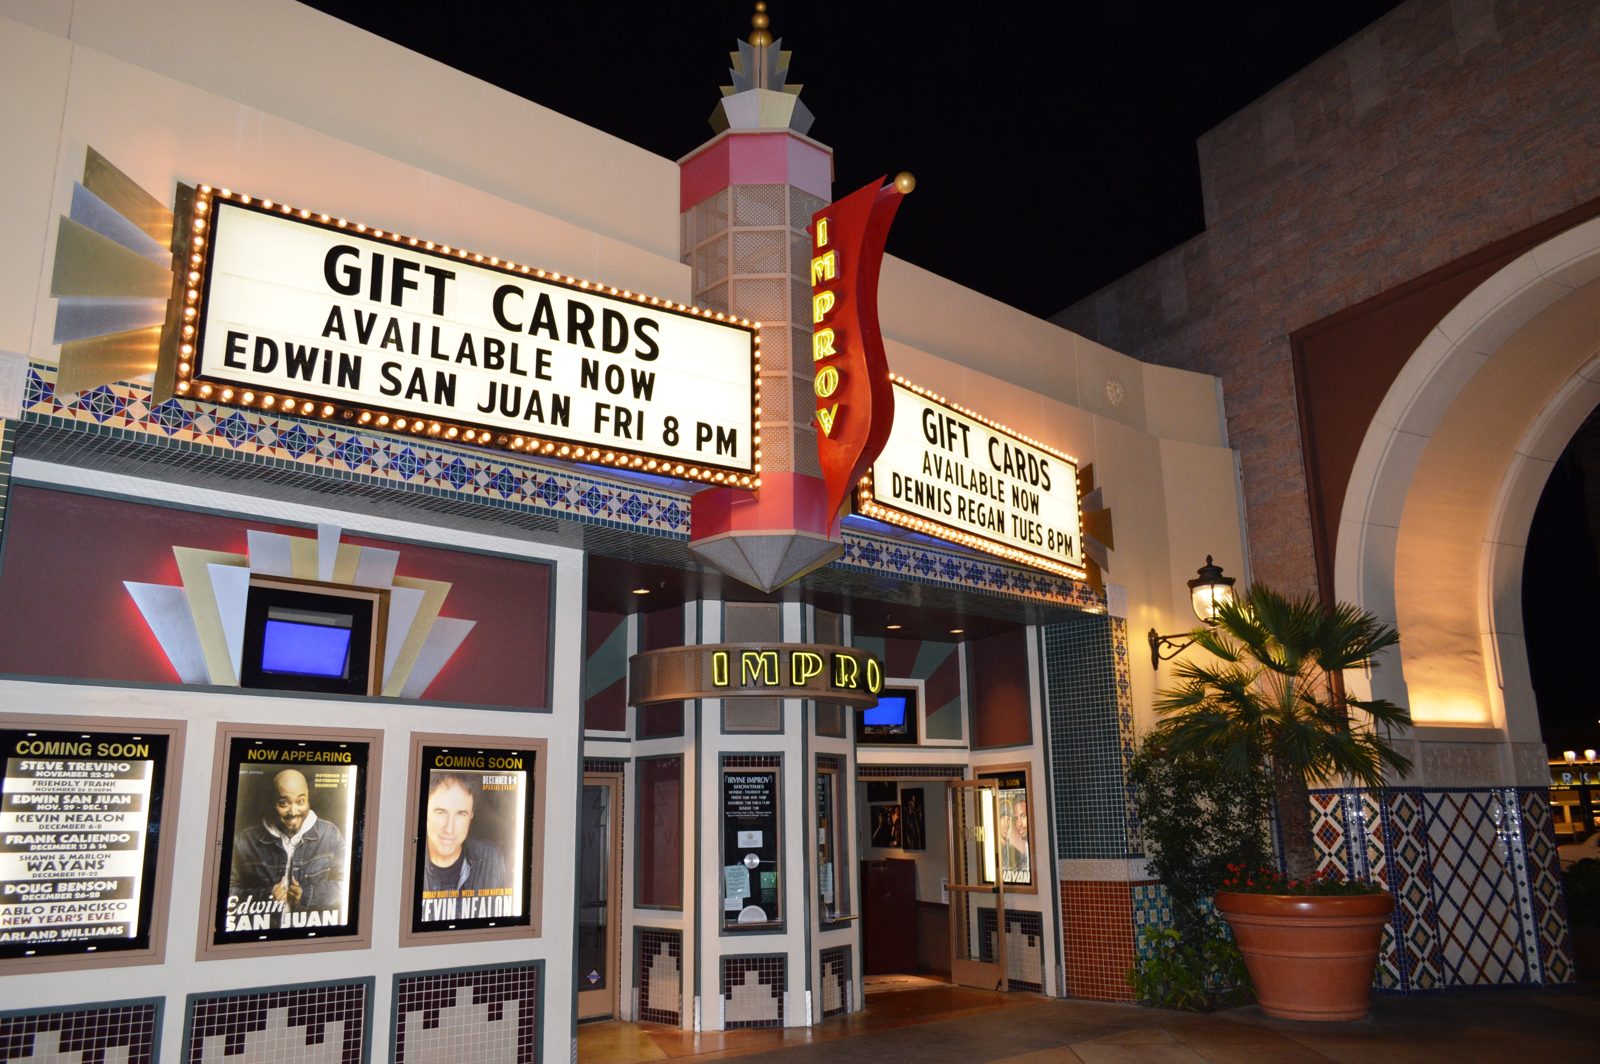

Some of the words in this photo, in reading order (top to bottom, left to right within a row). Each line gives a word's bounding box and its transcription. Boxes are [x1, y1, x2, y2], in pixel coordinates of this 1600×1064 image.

[323, 245, 456, 317] GIFT
[492, 284, 660, 361] CARDS
[811, 216, 840, 438] IMPROV
[322, 305, 553, 382] AVAILABLE
[581, 359, 656, 402] NOW
[223, 331, 362, 390] EDWIN
[380, 362, 457, 407] SAN
[477, 382, 571, 428] JUAN
[594, 403, 645, 441] FRI
[663, 416, 680, 447] 8
[696, 423, 738, 458] PM
[922, 407, 970, 458] GIFT
[988, 436, 1051, 492] CARDS
[922, 450, 1005, 503] AVAILABLE
[1012, 484, 1040, 517] NOW
[892, 471, 952, 515] DENNIS
[958, 495, 1005, 534] REGAN
[1011, 514, 1043, 546] TUES
[1047, 528, 1055, 551] 8
[1057, 532, 1073, 558] PM
[712, 650, 885, 694] IMPRO
[16, 740, 92, 757] COMING
[97, 742, 150, 758] SOON
[248, 749, 279, 761] NOW
[281, 750, 352, 763] APPEARING
[20, 761, 63, 771] STEVE
[68, 762, 131, 772] TREVINO
[435, 755, 485, 768] COMING
[488, 757, 523, 769] SOON
[727, 776, 746, 784] IRVINE
[747, 776, 769, 784] IMPROV
[12, 795, 59, 804] EDWIN
[63, 795, 92, 804] SAN
[96, 795, 131, 804] JUAN
[16, 814, 60, 823] KEVIN
[65, 814, 125, 823] NEALON
[5, 834, 57, 844] FRANK
[60, 833, 130, 843] CALIENDO
[27, 860, 105, 872] WAYANS
[1002, 870, 1031, 884] AYAN
[4, 883, 52, 895] DOUG
[57, 881, 118, 892] BENSON
[22, 893, 72, 901] DECEMBER
[1, 905, 45, 916] ABLO
[50, 902, 127, 914] FRANCISCO
[227, 895, 285, 916] Edwin
[2, 916, 32, 926] NEW
[38, 913, 83, 924] YEAR'S
[87, 912, 115, 921] EVE!
[225, 913, 271, 933] SAN
[280, 909, 339, 929] JUAN
[0, 930, 58, 942] ARLAND
[61, 926, 124, 937] WILLIAMS
